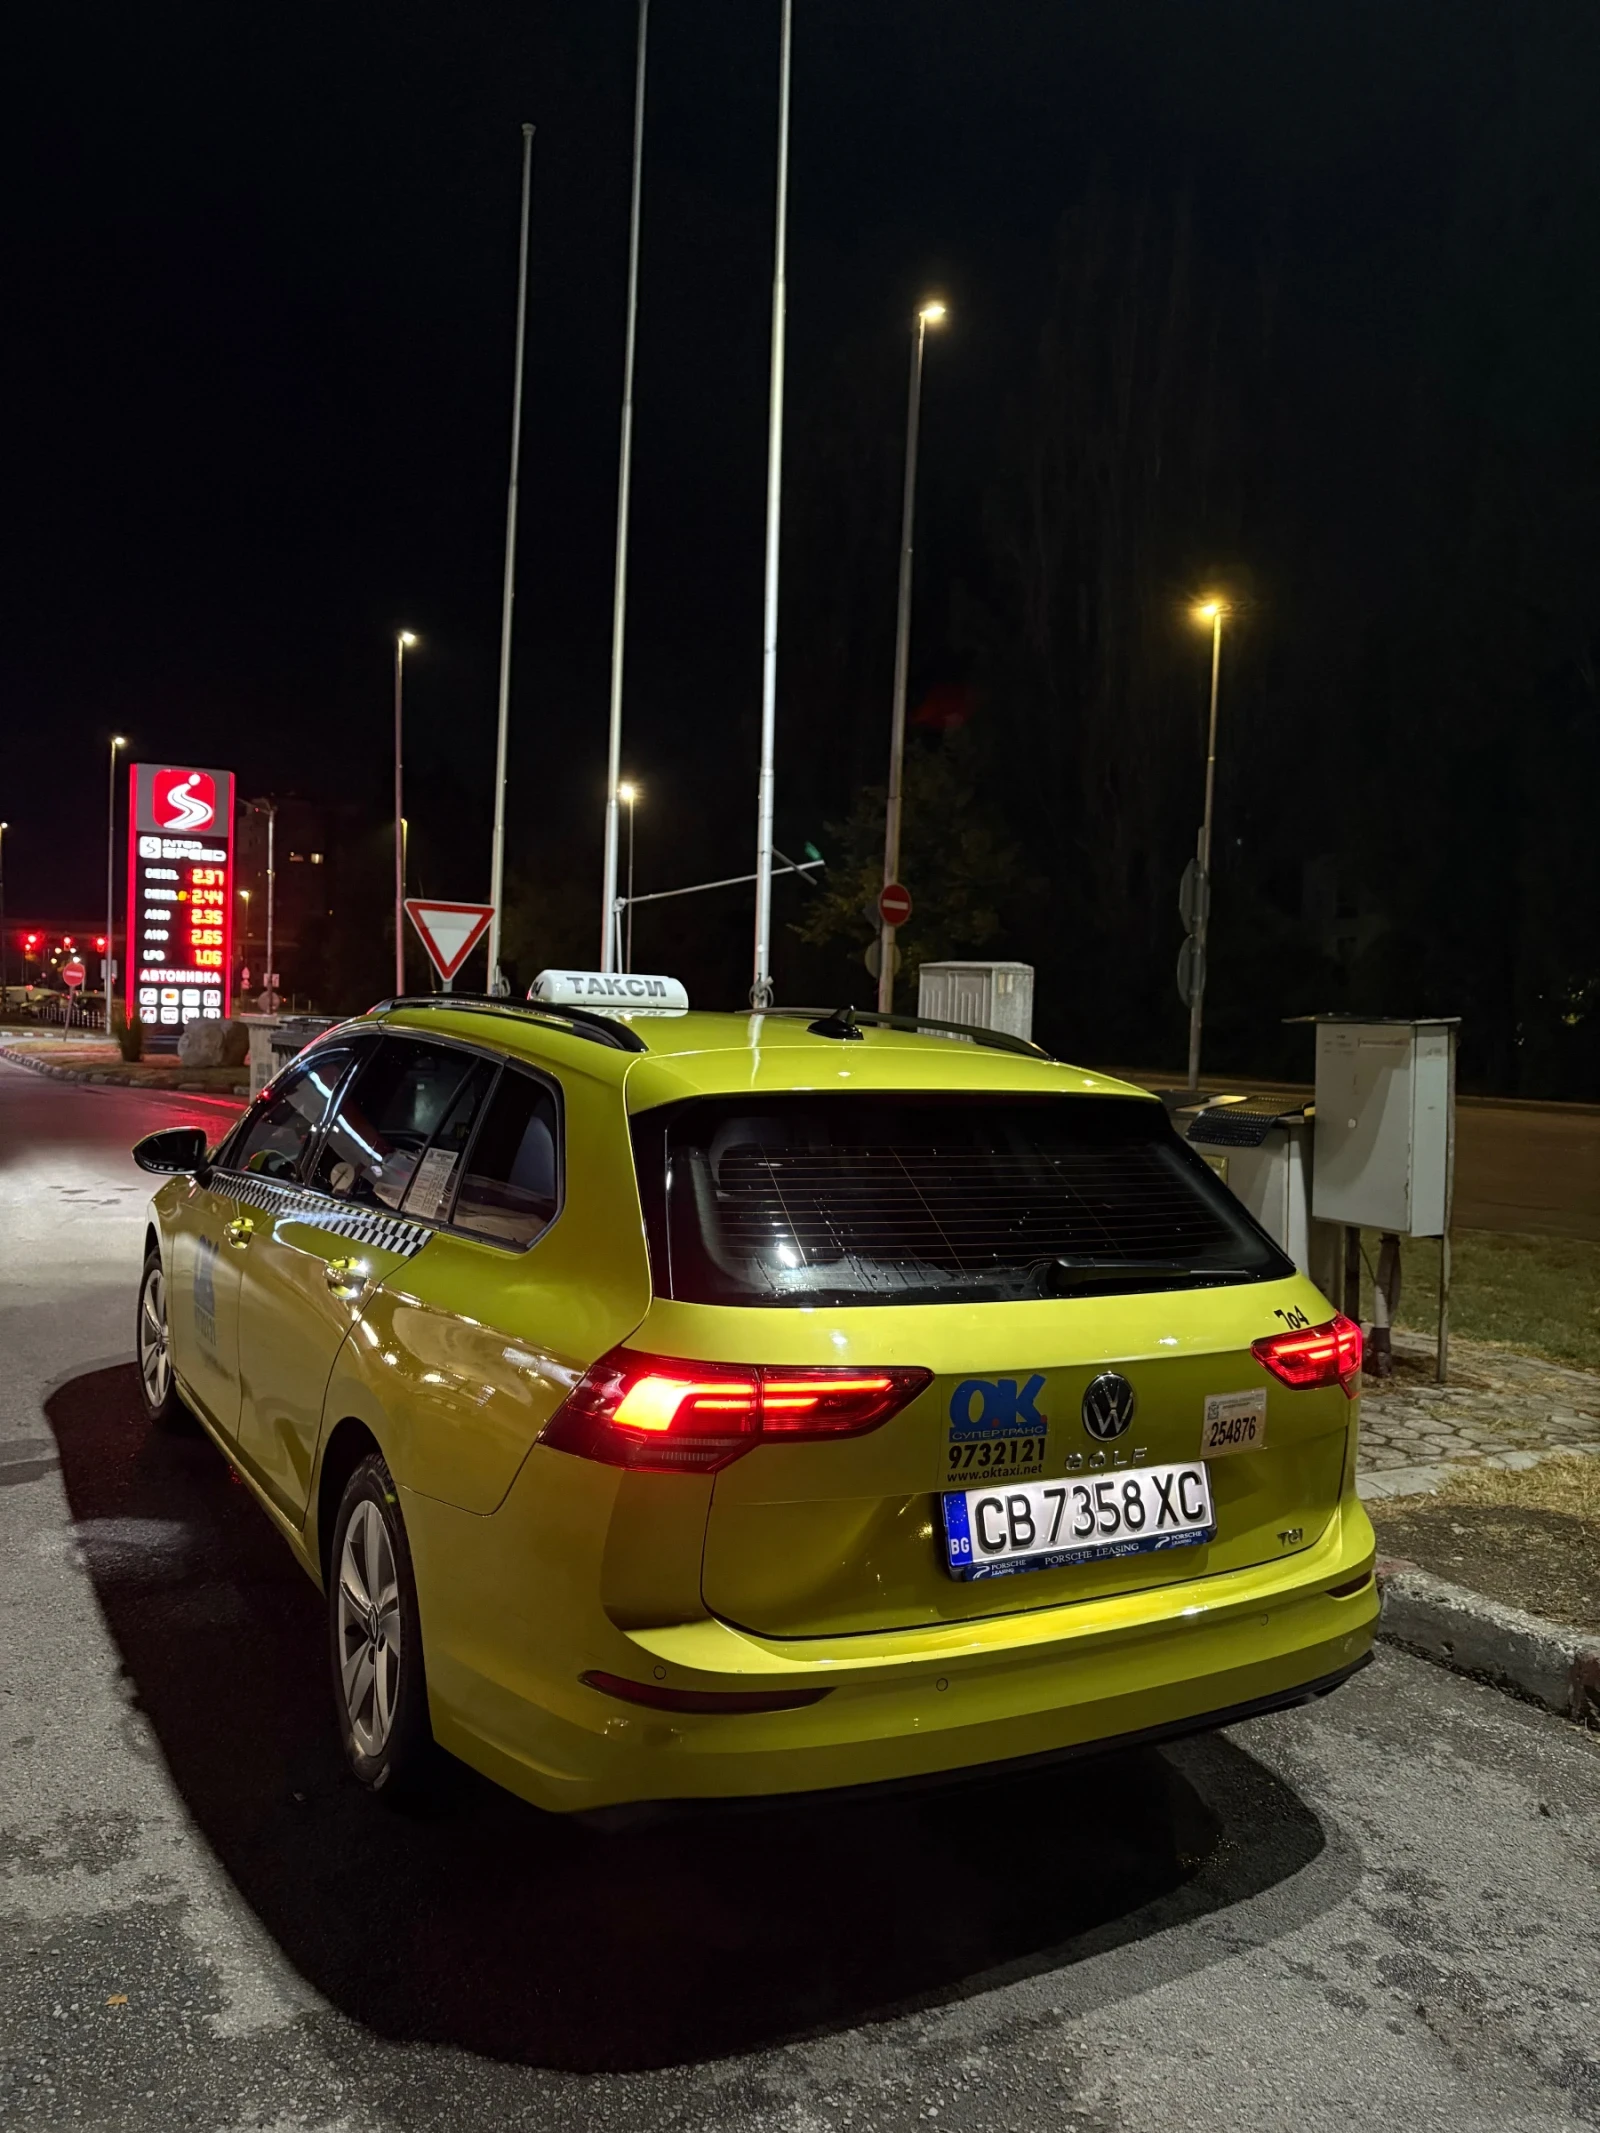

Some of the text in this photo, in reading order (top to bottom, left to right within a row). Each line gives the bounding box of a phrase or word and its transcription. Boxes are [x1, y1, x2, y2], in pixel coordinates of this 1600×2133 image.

[162, 839, 203, 849] INTER
[162, 848, 227, 861] SPEED
[145, 868, 224, 886] DIESEL 2.37
[191, 889, 224, 905] 2.44
[191, 908, 223, 925] 2.35
[191, 928, 222, 945] 2.65
[143, 949, 222, 967] LPG 1.06
[140, 969, 221, 984] АВТОМИВКА
[566, 977, 667, 997] ТАКСИ
[1273, 1305, 1310, 1330] 704
[952, 1425, 1044, 1440] СУПЕРТРАНС
[1209, 1416, 1257, 1447] 254876
[949, 1438, 1045, 1469] 9732121
[1065, 1447, 1148, 1471] GOLF
[947, 1464, 1042, 1482] www.oktaxi.net
[1042, 1480, 1146, 1544] 7358
[1171, 1531, 1203, 1541] PORSCHE
[950, 1538, 970, 1555] BG
[1045, 1543, 1140, 1565] PORSCHE LEASING
[991, 1559, 1027, 1570] PORSCHE
